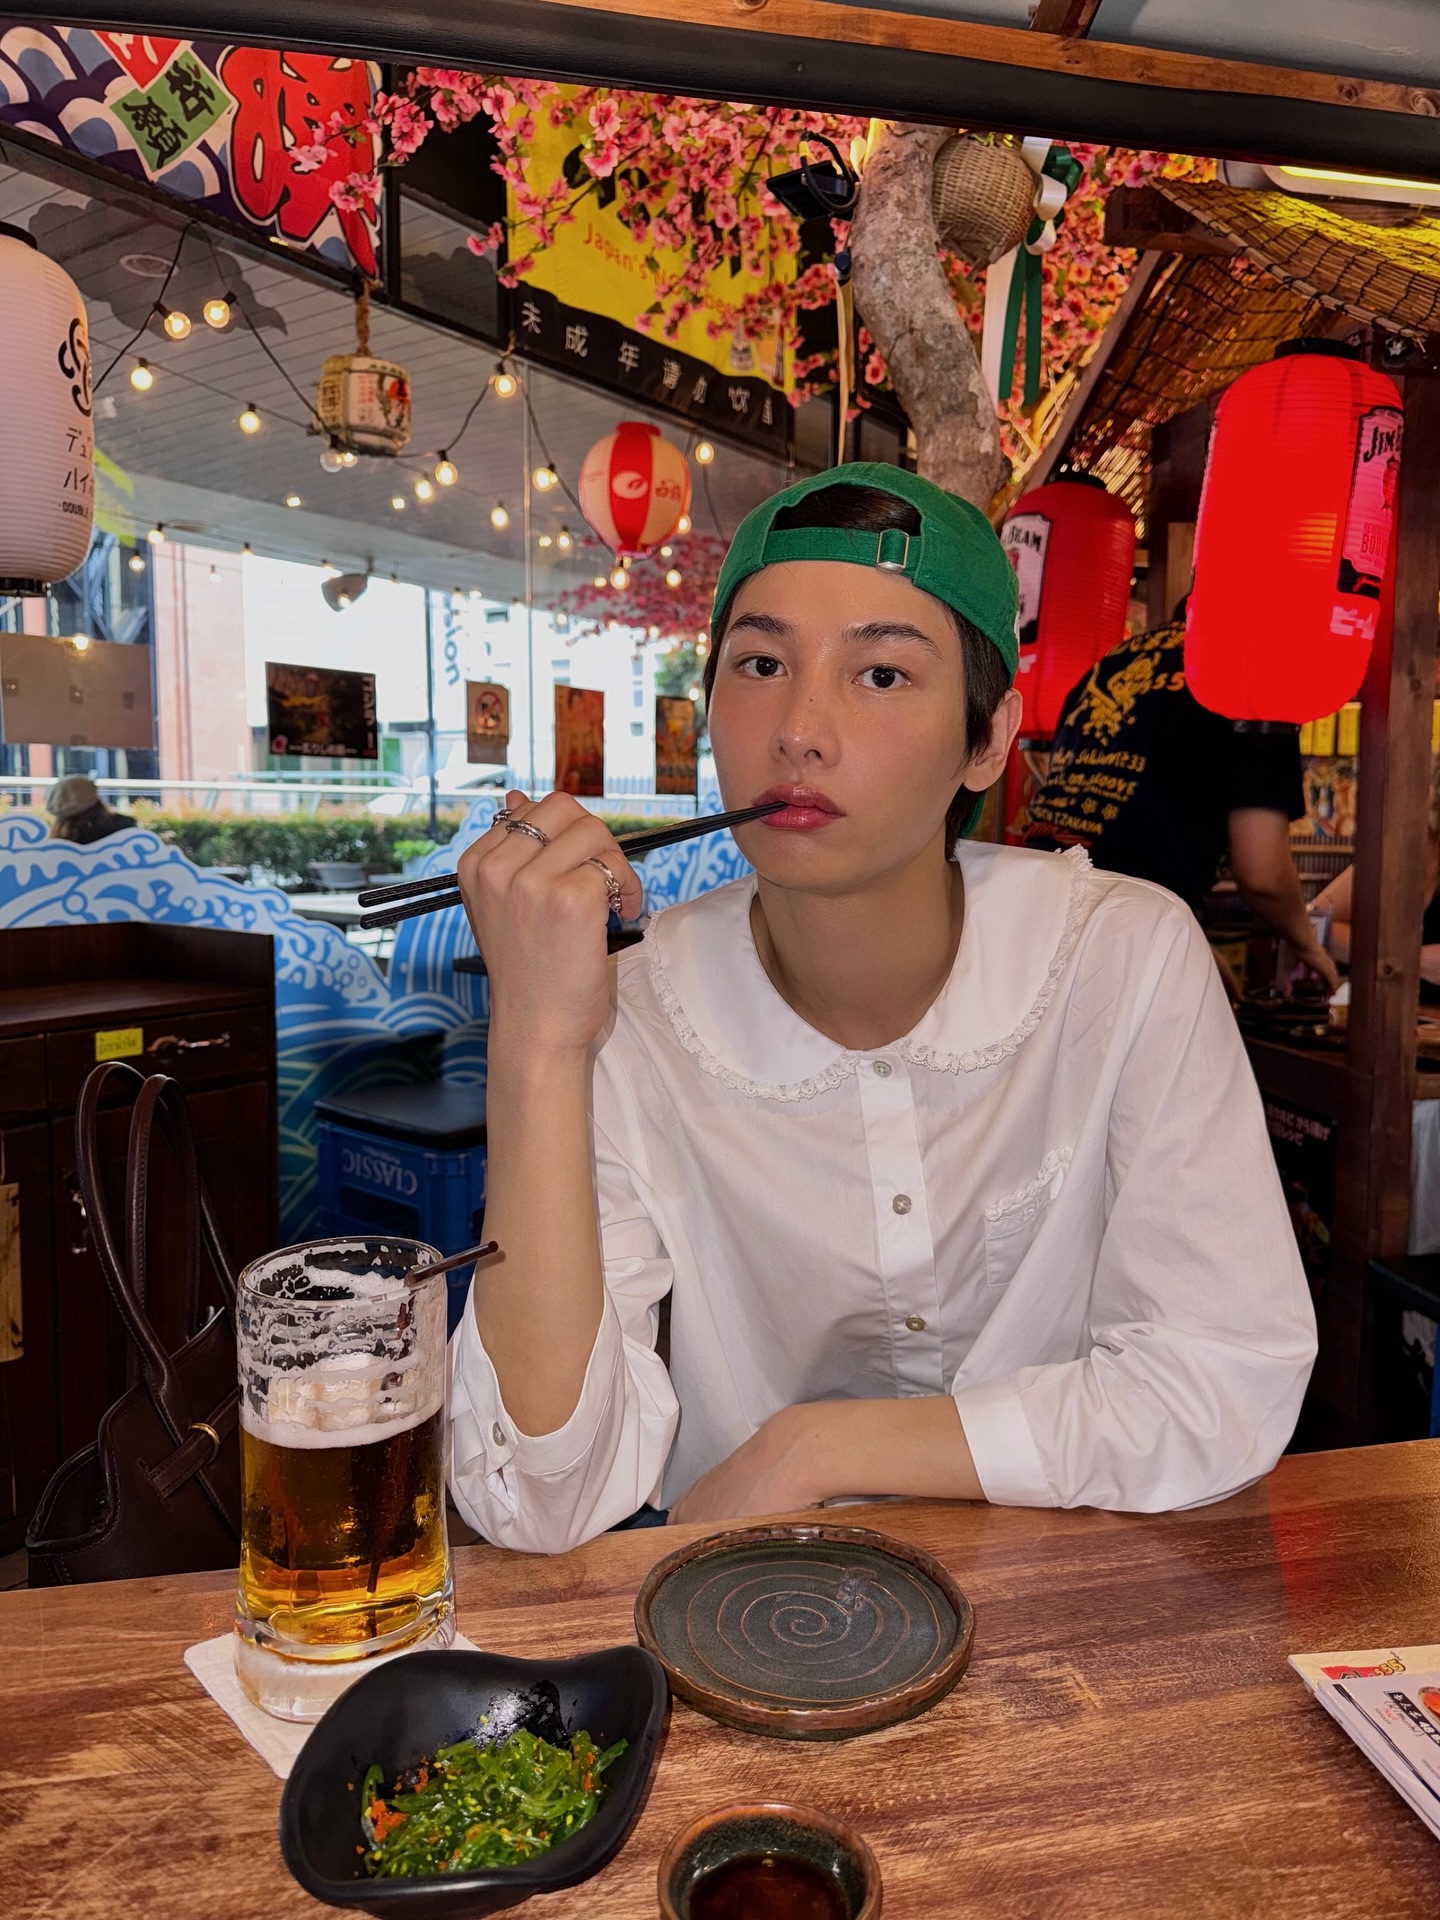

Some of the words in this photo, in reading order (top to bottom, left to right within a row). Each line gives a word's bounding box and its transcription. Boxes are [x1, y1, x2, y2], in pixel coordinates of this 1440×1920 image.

[122, 60, 215, 170] 祈願
[582, 222, 651, 283] Japan's
[1363, 426, 1397, 463] JIM
[341, 1148, 418, 1197] CLASSIC
